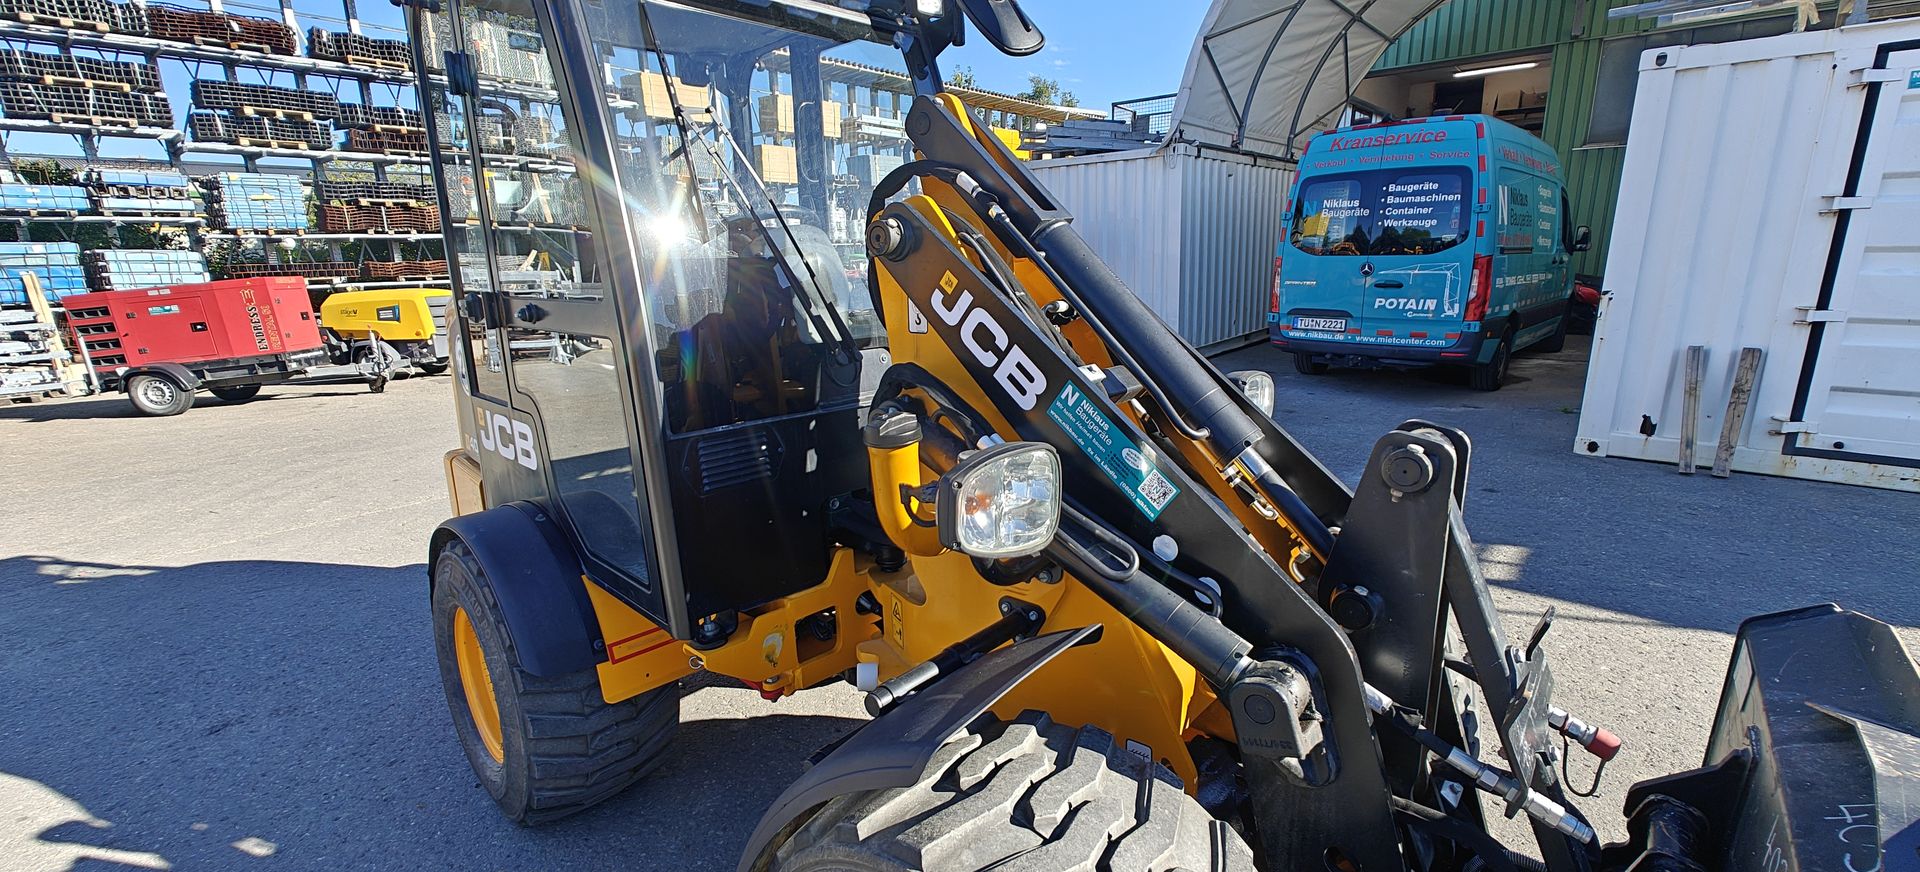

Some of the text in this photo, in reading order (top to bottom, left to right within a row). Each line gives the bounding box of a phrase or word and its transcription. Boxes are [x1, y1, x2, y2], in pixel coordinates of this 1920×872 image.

[1330, 128, 1447, 152] Kranservice
[1430, 150, 1470, 159] Service
[1389, 181, 1439, 193] Baugeräte
[1387, 193, 1461, 204] Baumaschinen
[1498, 185, 1508, 226] N
[1303, 199, 1360, 217] N Niklaus
[1321, 208, 1370, 218] Baugeräte
[1385, 206, 1433, 215] Container
[1384, 218, 1437, 228] Werkzeuge
[1374, 298, 1437, 310] POTAIN
[246, 305, 269, 351] ENDRESS
[1315, 319, 1321, 328] N
[1322, 320, 1343, 329] 2221
[1288, 330, 1446, 346] www.nikbau.de www.mietcenter.com
[931, 288, 1047, 411] JCB
[1060, 384, 1109, 430] N Niklaus
[1076, 406, 1112, 445] Baugeräte
[480, 410, 538, 471] JCB
